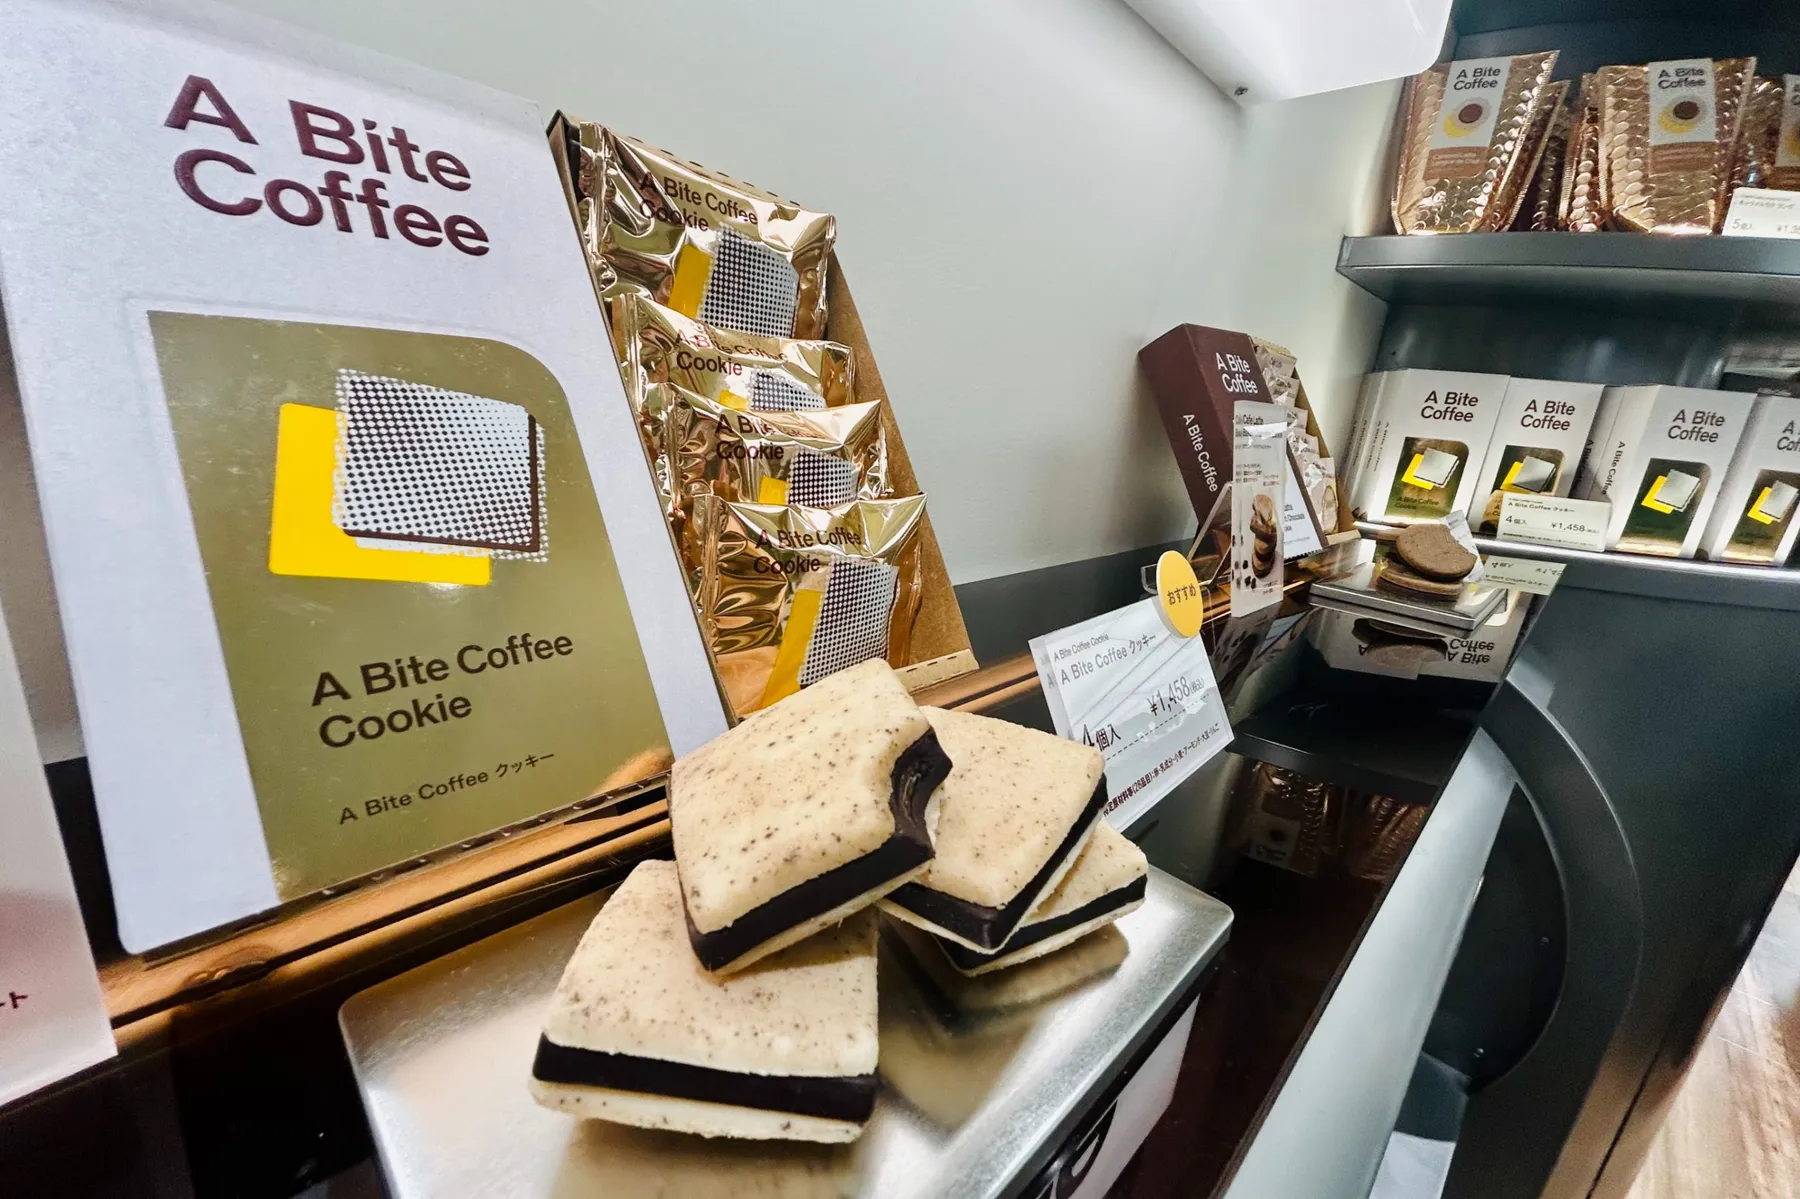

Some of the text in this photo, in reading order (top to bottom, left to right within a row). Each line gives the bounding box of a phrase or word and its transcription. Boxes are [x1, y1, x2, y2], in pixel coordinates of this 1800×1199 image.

[1456, 66, 1501, 79] A Bite
[1658, 67, 1705, 79] A Bite
[1453, 78, 1498, 90] Coffee
[1658, 77, 1706, 90] Coffee
[164, 74, 472, 192] A Bite
[173, 148, 490, 256] Coffee
[640, 172, 758, 225] A Bite Coffee
[639, 200, 709, 232] Cookie
[676, 351, 743, 376] Cookie
[1215, 352, 1228, 371] A
[1226, 353, 1251, 373] Bite
[1221, 373, 1259, 394] Coffee
[1423, 390, 1478, 407] A Bite
[1524, 399, 1576, 416] A Bite
[715, 413, 734, 434] A
[1420, 406, 1474, 422] Coffee
[1520, 414, 1571, 431] Coffee
[1672, 409, 1725, 427] A Bite
[1667, 425, 1719, 443] Coffee
[1782, 420, 1795, 434] A
[716, 440, 784, 459] Cookie
[1183, 414, 1219, 492] A Bite Coffee
[1601, 441, 1626, 495] A Bite Coffee
[755, 526, 862, 549] A Bite Coffee
[753, 555, 821, 574] Cookie
[1167, 583, 1197, 605] おすすめ
[1054, 633, 1110, 662] A Bite Coffee Cookie
[311, 632, 574, 707] A Bite Coffee
[1061, 669, 1071, 685] A
[1070, 660, 1094, 680] Bite
[1094, 647, 1128, 669] Coffee
[1128, 634, 1156, 655] クッキー
[319, 693, 472, 748] Cookie
[339, 752, 555, 825] A Bite Coffee クッキー
